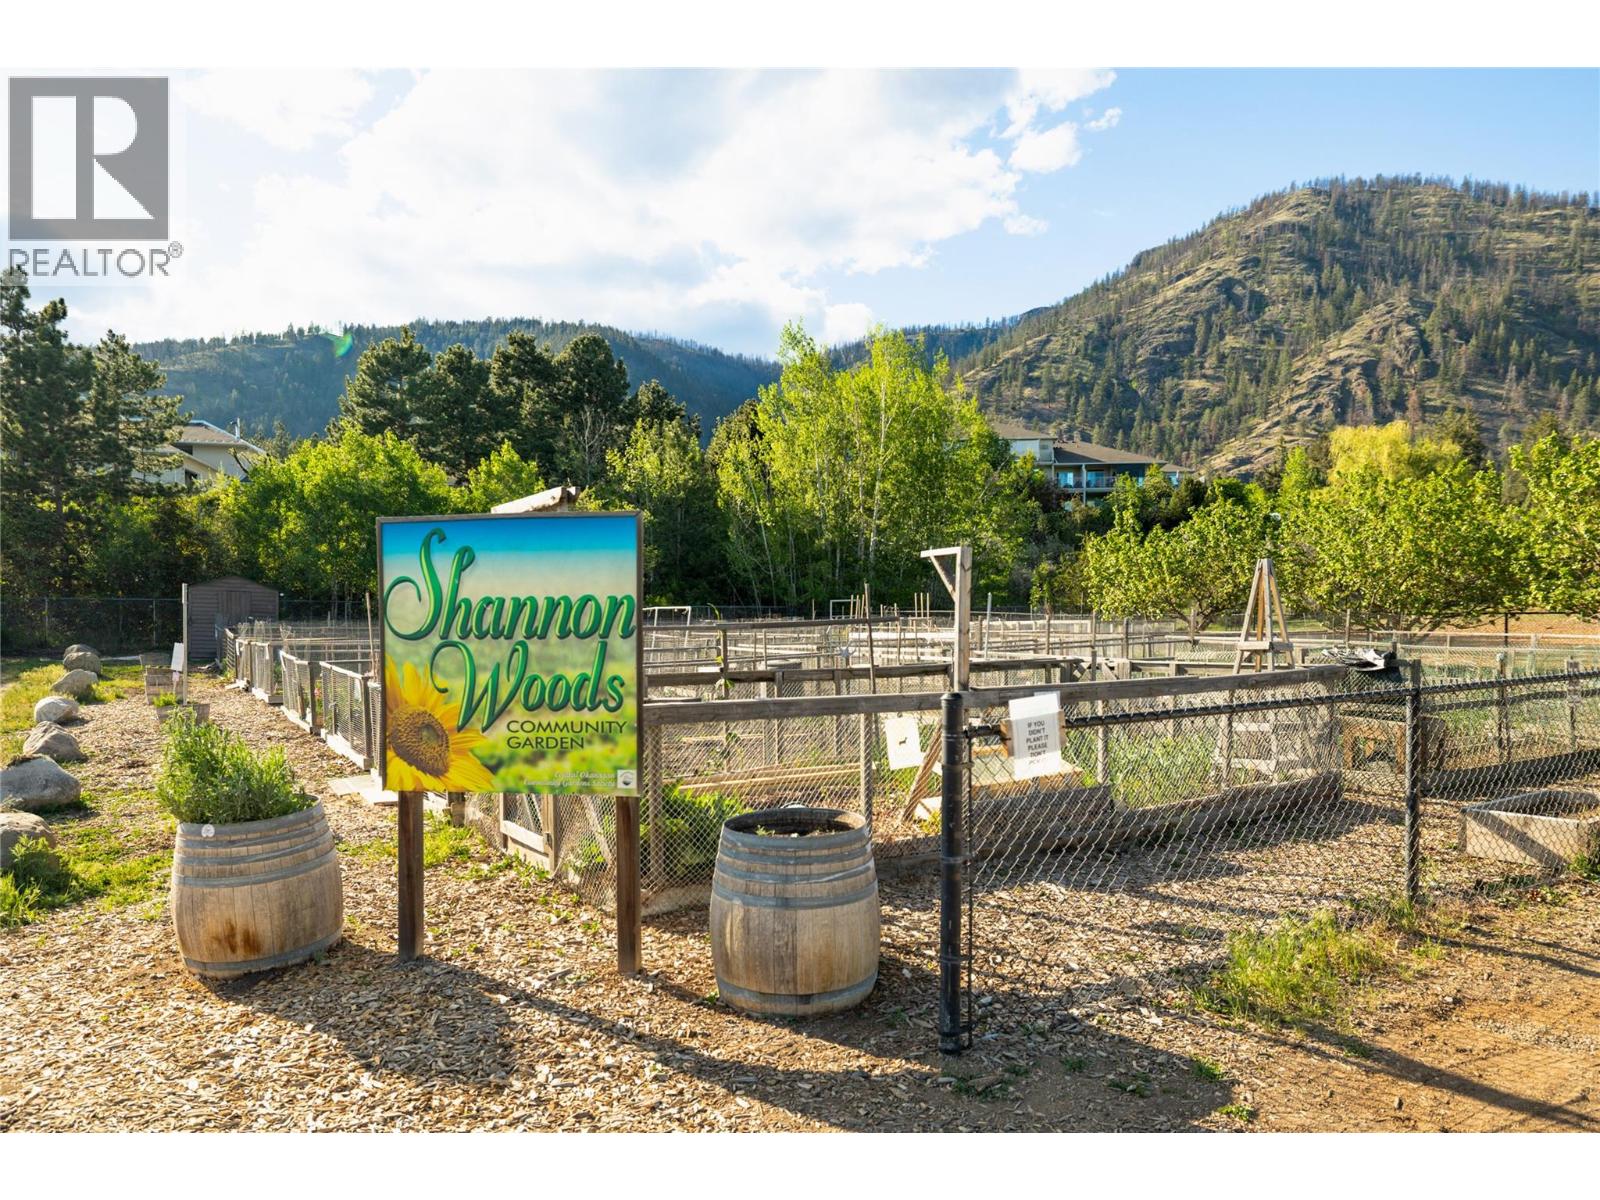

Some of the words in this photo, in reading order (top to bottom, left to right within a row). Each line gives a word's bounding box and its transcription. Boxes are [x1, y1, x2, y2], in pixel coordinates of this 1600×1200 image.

[384, 527, 637, 641] Shannon
[430, 640, 625, 733] Woods
[506, 720, 628, 734] COMMUNITY
[1034, 720, 1045, 728] YOU
[506, 736, 585, 750] GARDEN
[1026, 735, 1043, 744] PLANT
[1028, 743, 1048, 751] PLEASE
